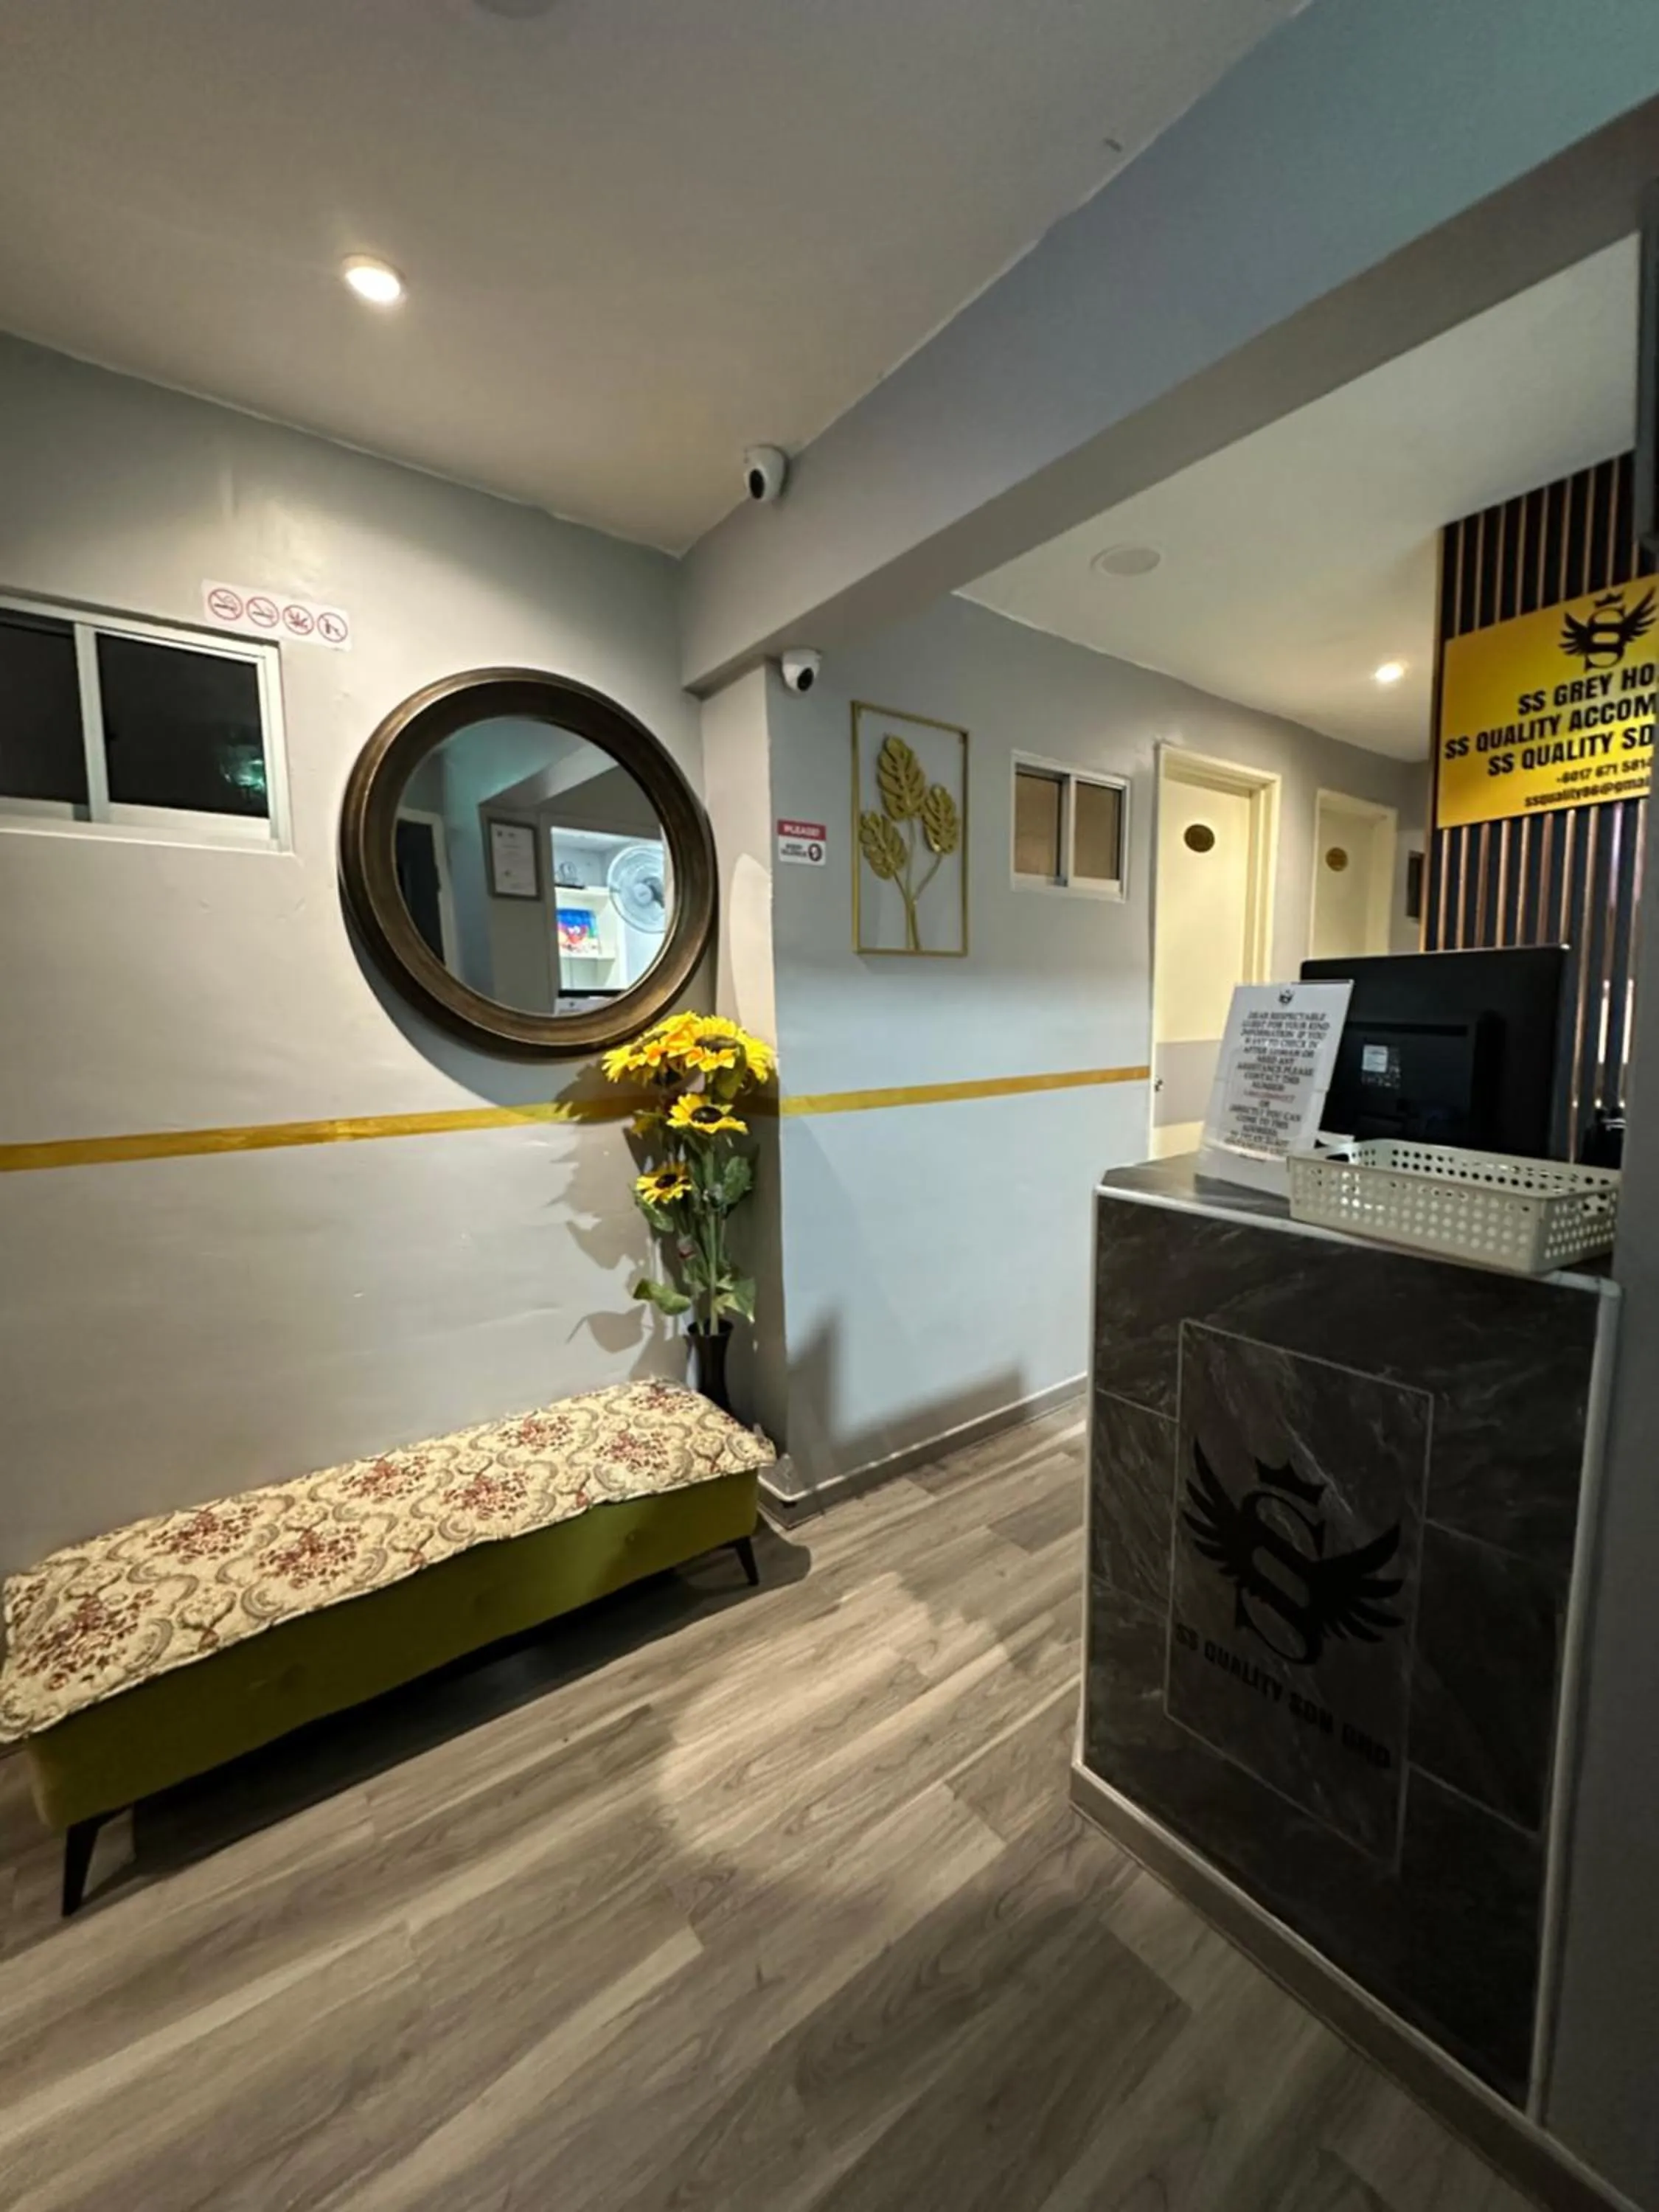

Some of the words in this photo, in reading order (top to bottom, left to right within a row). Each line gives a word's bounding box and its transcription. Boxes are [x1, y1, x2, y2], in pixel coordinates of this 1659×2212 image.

[1517, 691, 1545, 716] SS
[1554, 672, 1613, 707] GREY
[1621, 662, 1655, 691] HO
[1444, 735, 1470, 759] SS
[1476, 714, 1562, 753] QUALITY
[1568, 693, 1656, 732] ACCOM
[1488, 753, 1514, 776] SS
[1521, 732, 1613, 770] QUALITY
[1203, 1640, 1283, 1702] QUALITY
